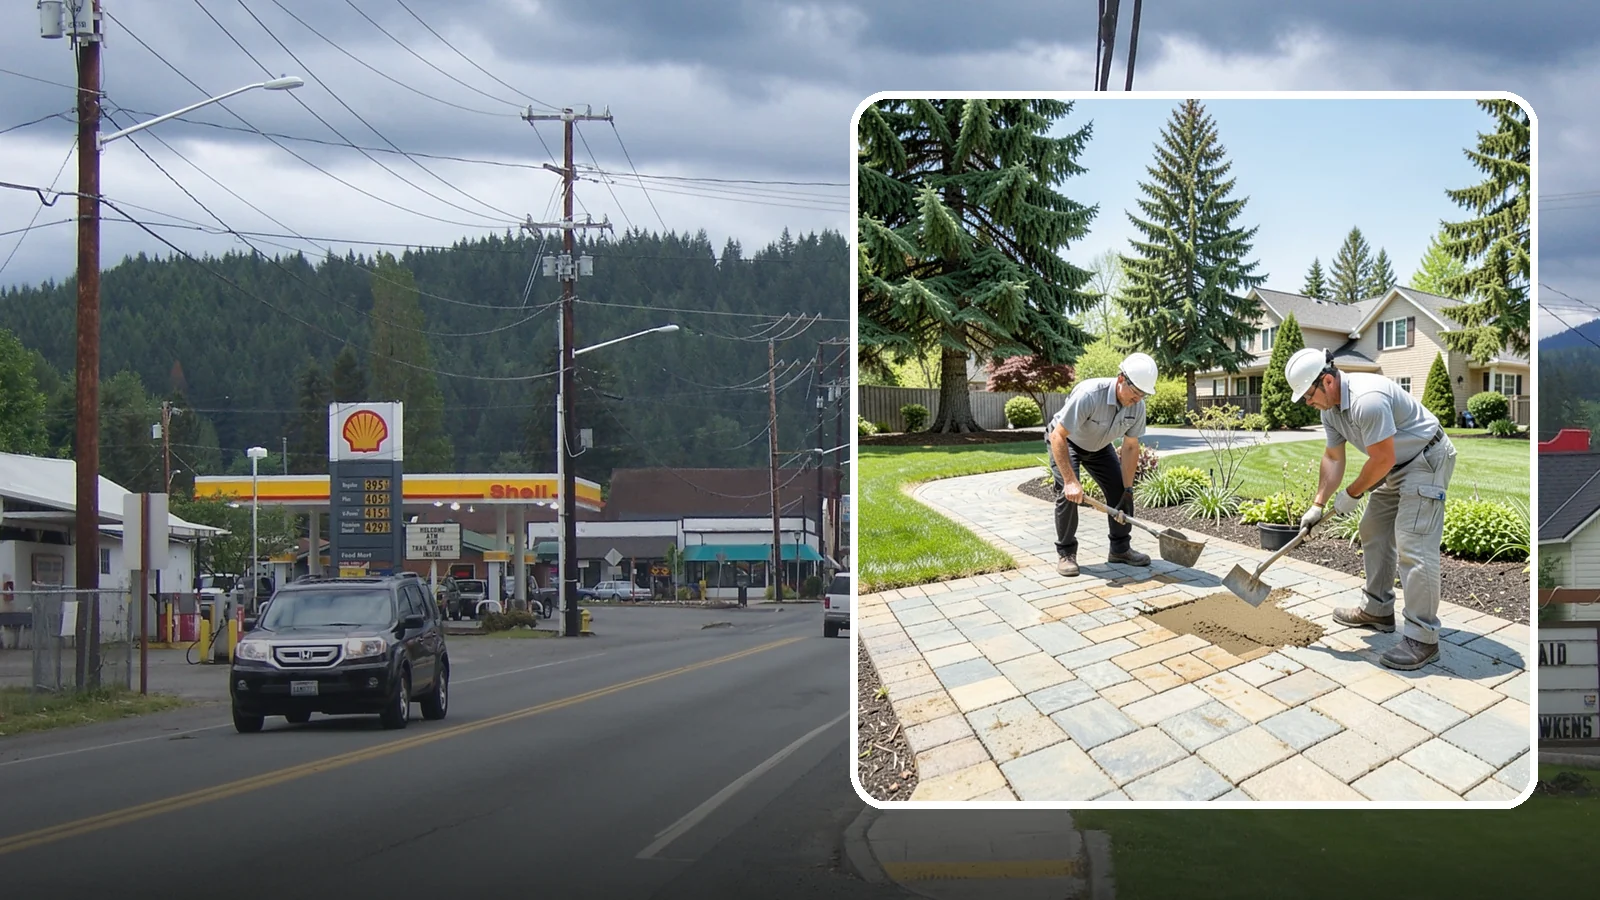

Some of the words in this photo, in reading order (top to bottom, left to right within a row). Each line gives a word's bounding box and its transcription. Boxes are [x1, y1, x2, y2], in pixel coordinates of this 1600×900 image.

[366, 480, 384, 490] 395
[490, 484, 547, 499] Shell
[366, 494, 384, 504] 405
[366, 508, 384, 518] 415
[366, 522, 384, 532] 429
